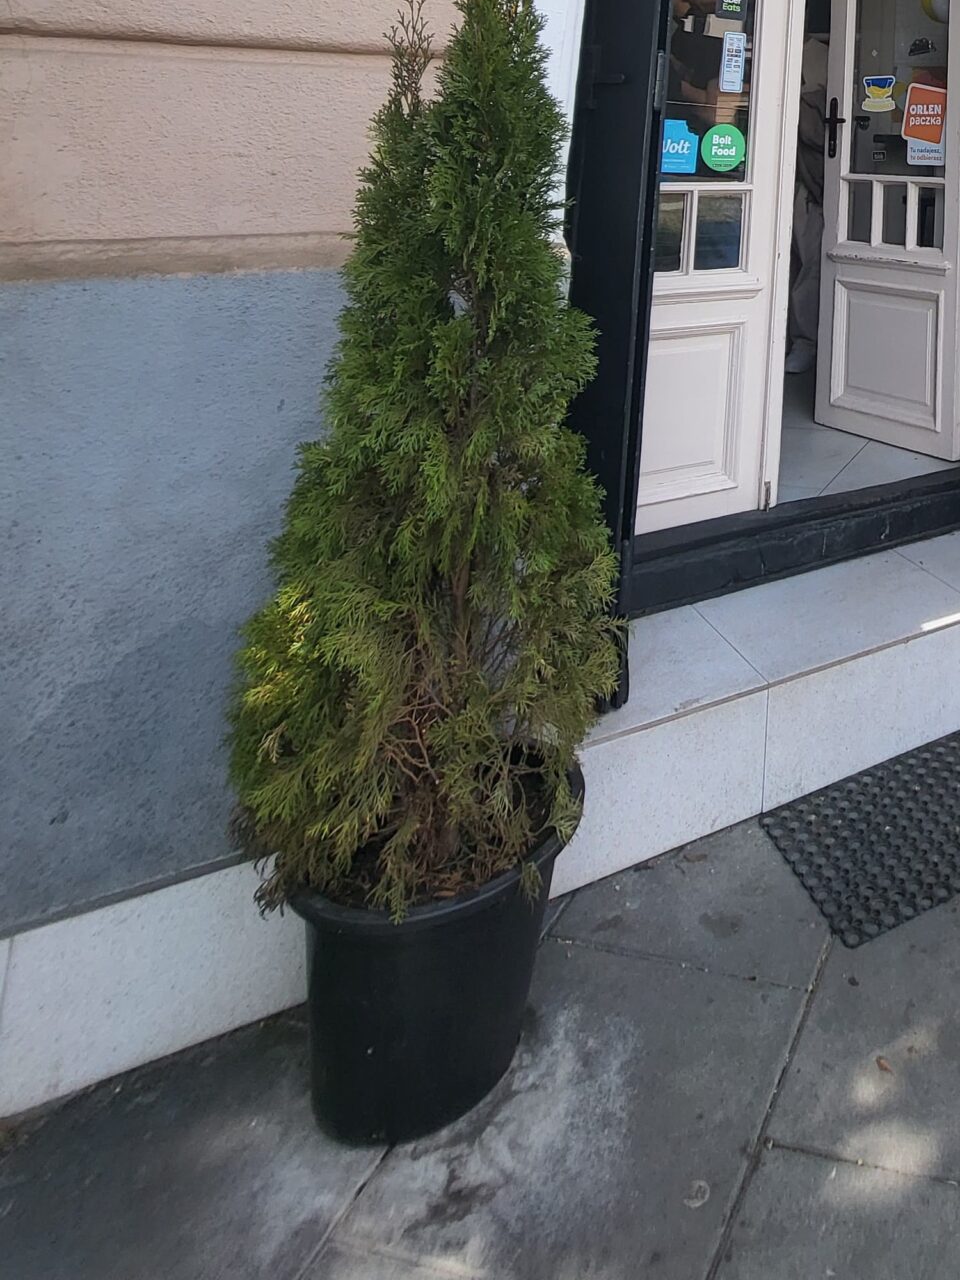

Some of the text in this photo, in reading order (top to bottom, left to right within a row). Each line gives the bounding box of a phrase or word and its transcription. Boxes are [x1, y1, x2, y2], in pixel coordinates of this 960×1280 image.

[722, 3, 741, 12] Eats
[909, 104, 942, 115] ORLEN
[909, 116, 942, 127] paczka
[712, 134, 732, 144] Bolt
[711, 146, 736, 156] Food
